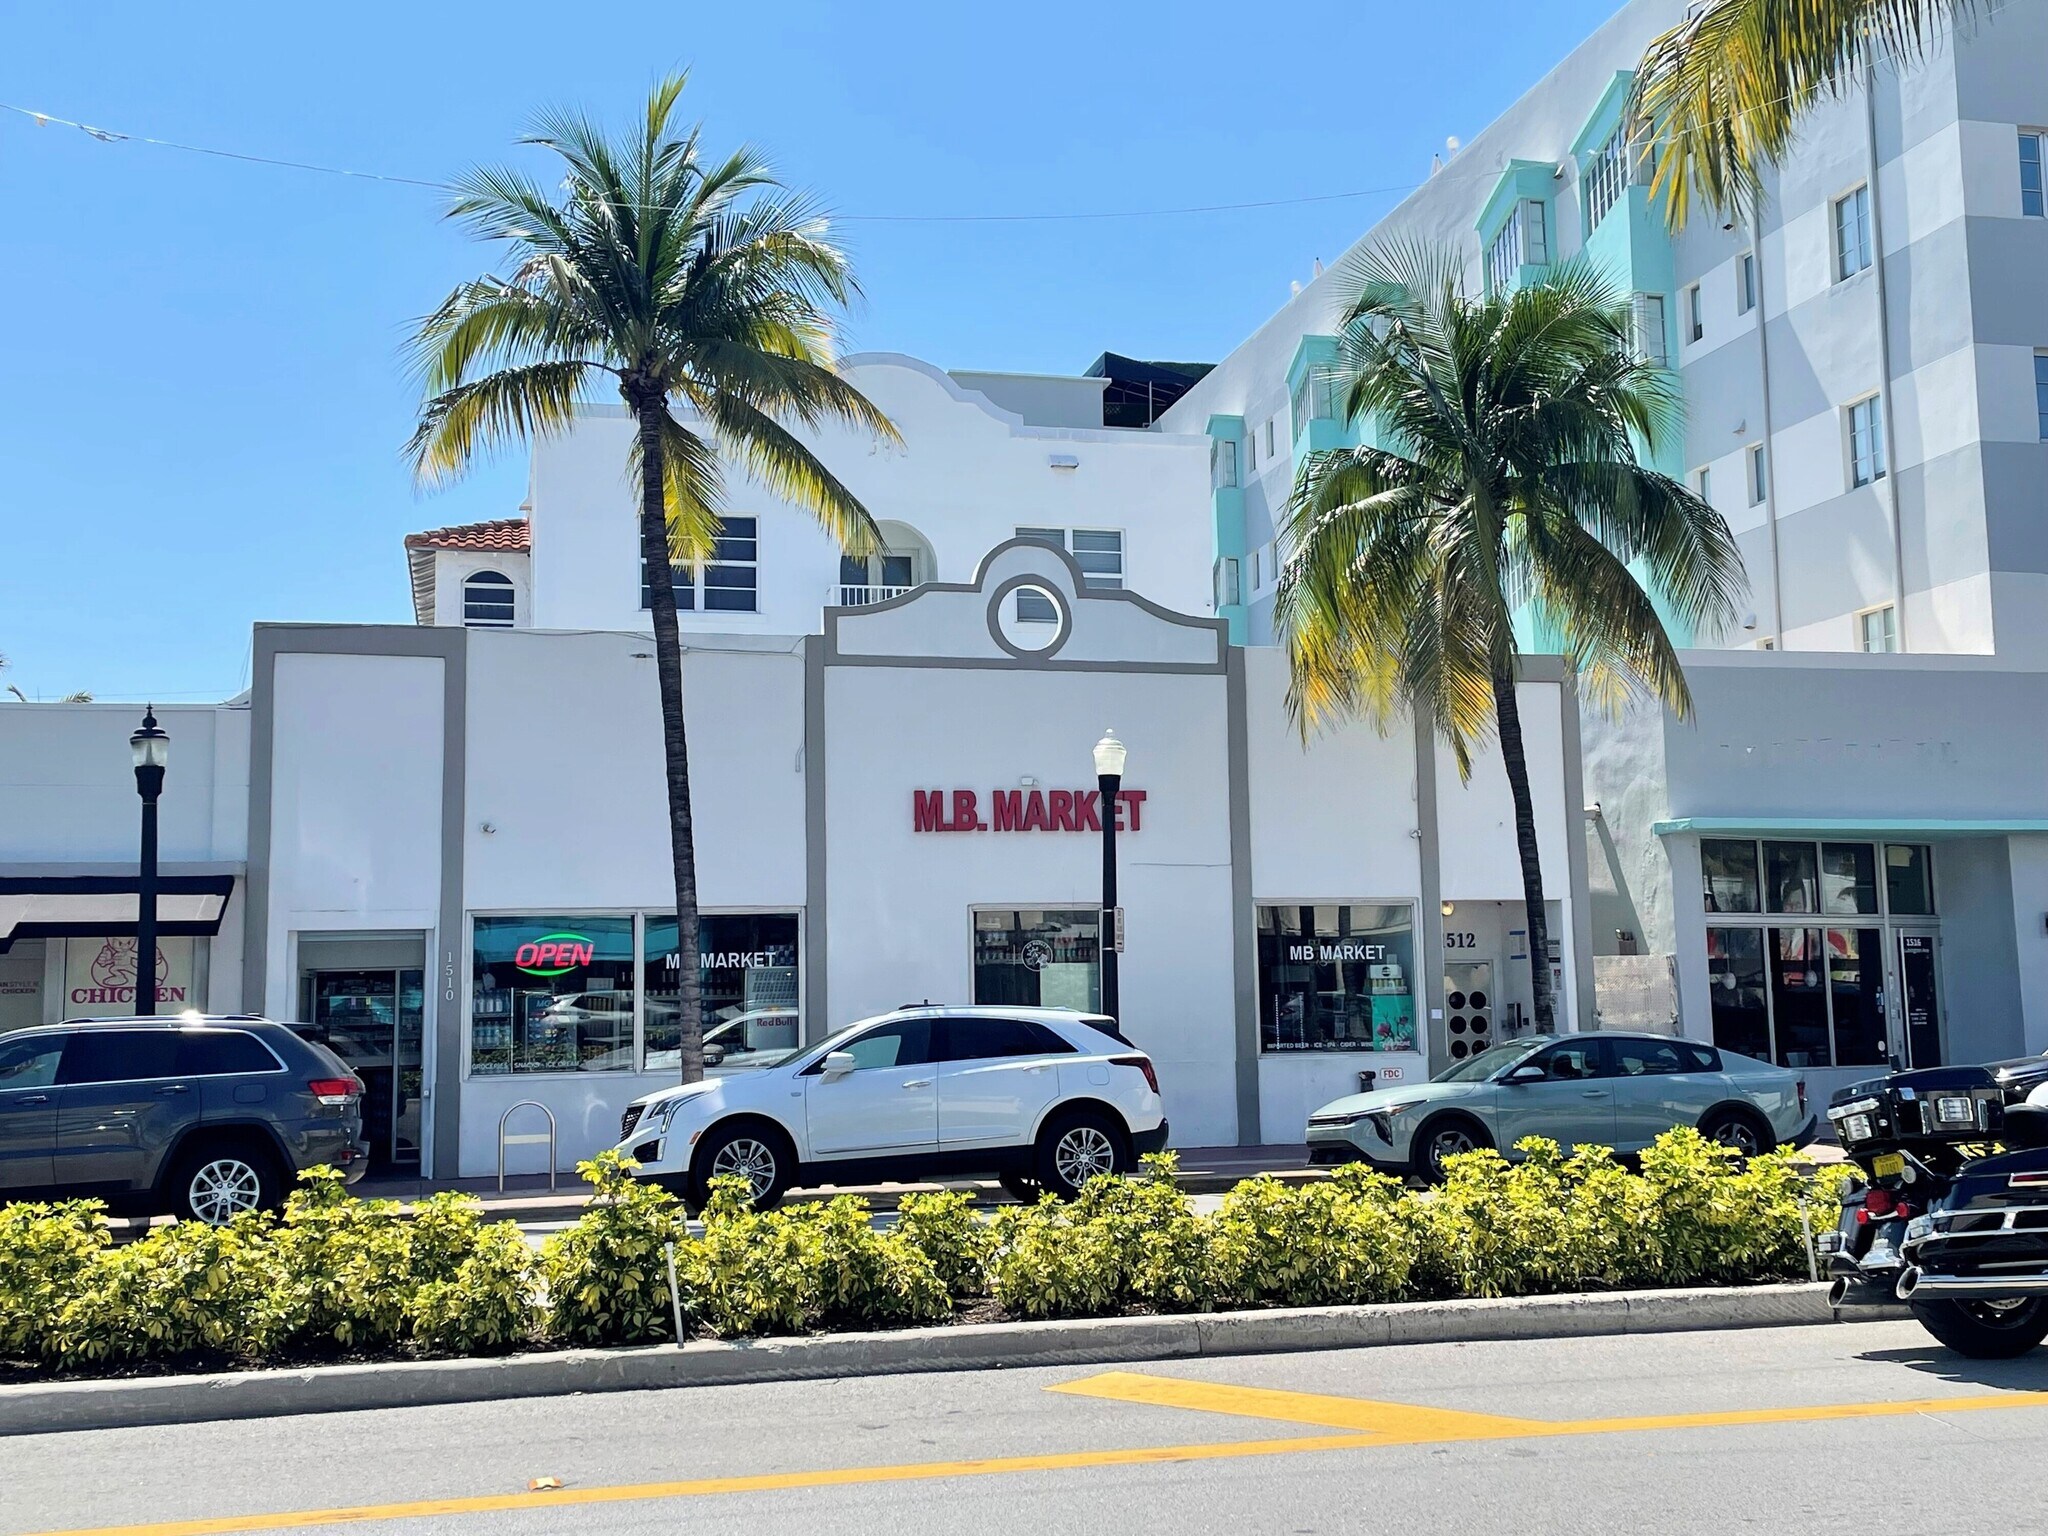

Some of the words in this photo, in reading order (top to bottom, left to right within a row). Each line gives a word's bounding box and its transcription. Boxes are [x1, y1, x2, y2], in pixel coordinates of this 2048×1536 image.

[914, 790, 988, 832] M.B.
[1443, 932, 1476, 948] 512
[514, 943, 594, 967] OPEN
[700, 952, 776, 969] MARKET
[1289, 945, 1314, 960] MB
[1320, 944, 1385, 960] MARKET
[445, 951, 454, 1001] 1510
[71, 987, 186, 1004] CHICEN
[756, 1018, 774, 1027] Red
[775, 1017, 793, 1026] Bull
[1383, 1070, 1400, 1078] FDC
